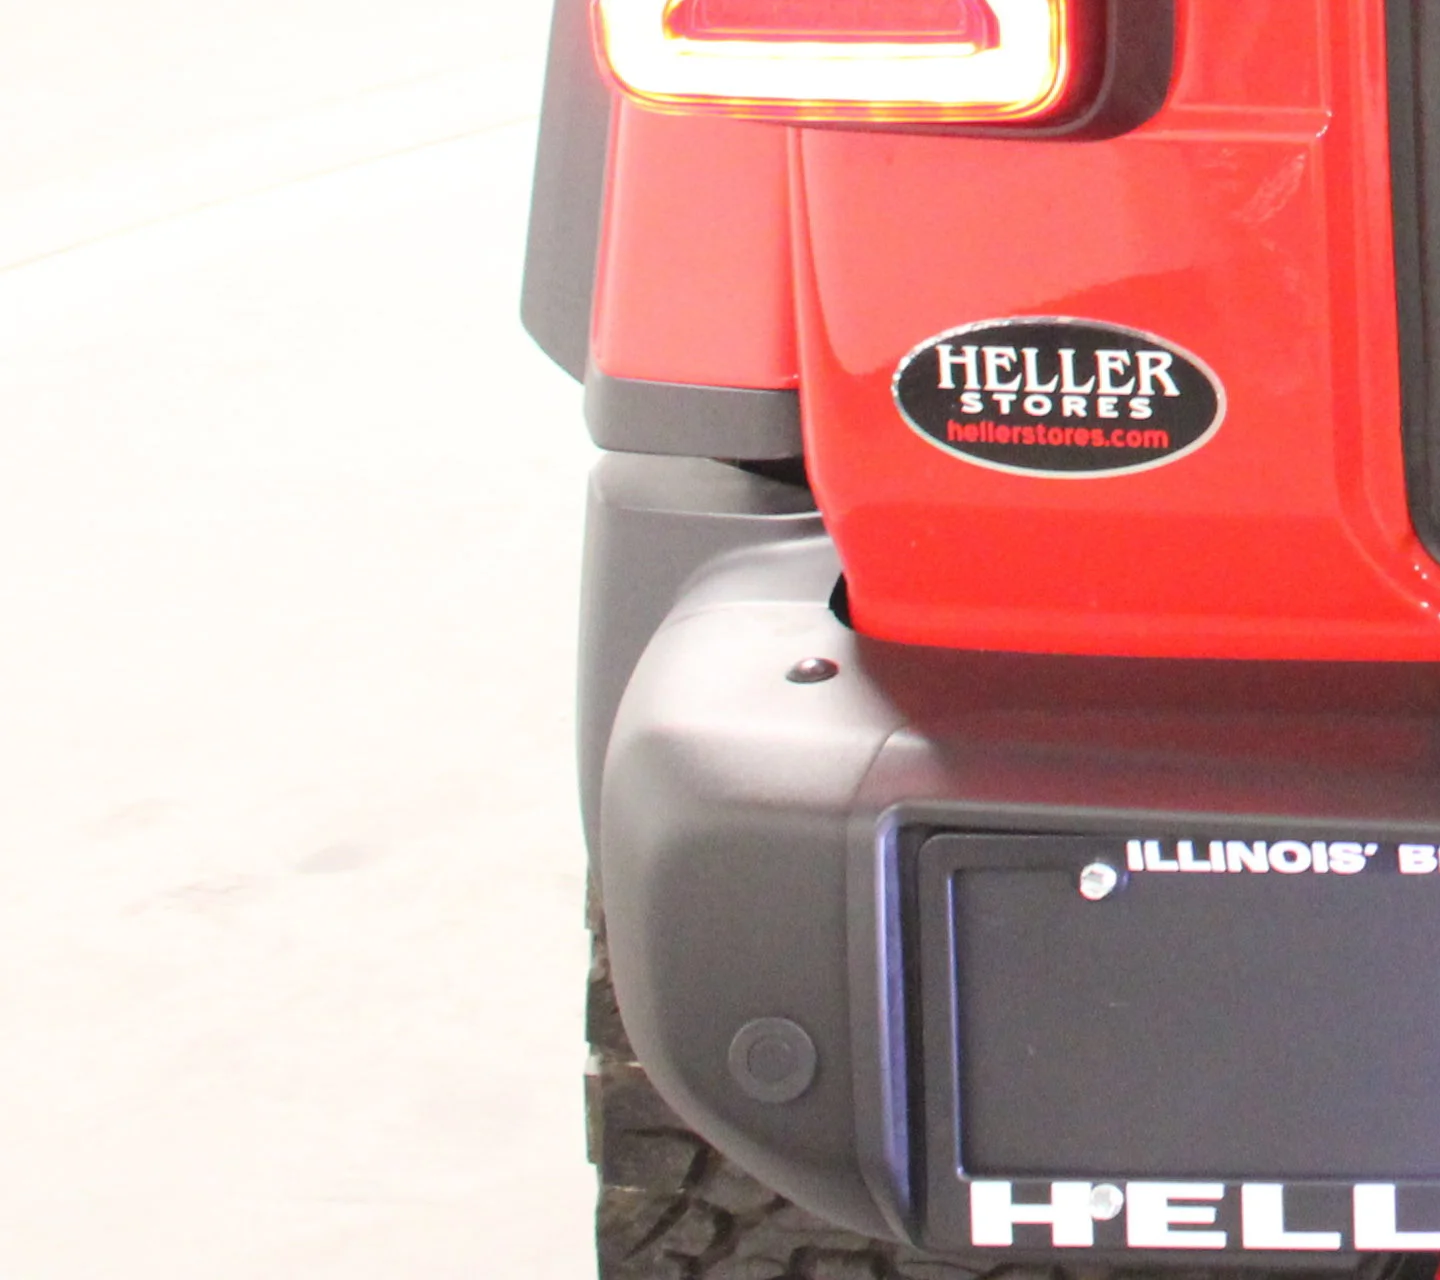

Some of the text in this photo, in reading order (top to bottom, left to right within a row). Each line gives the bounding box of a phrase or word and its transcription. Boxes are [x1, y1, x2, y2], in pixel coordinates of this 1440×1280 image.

[935, 344, 1181, 397] HELLER
[960, 392, 1154, 420] STORES
[946, 419, 1170, 449] hellerstores.com
